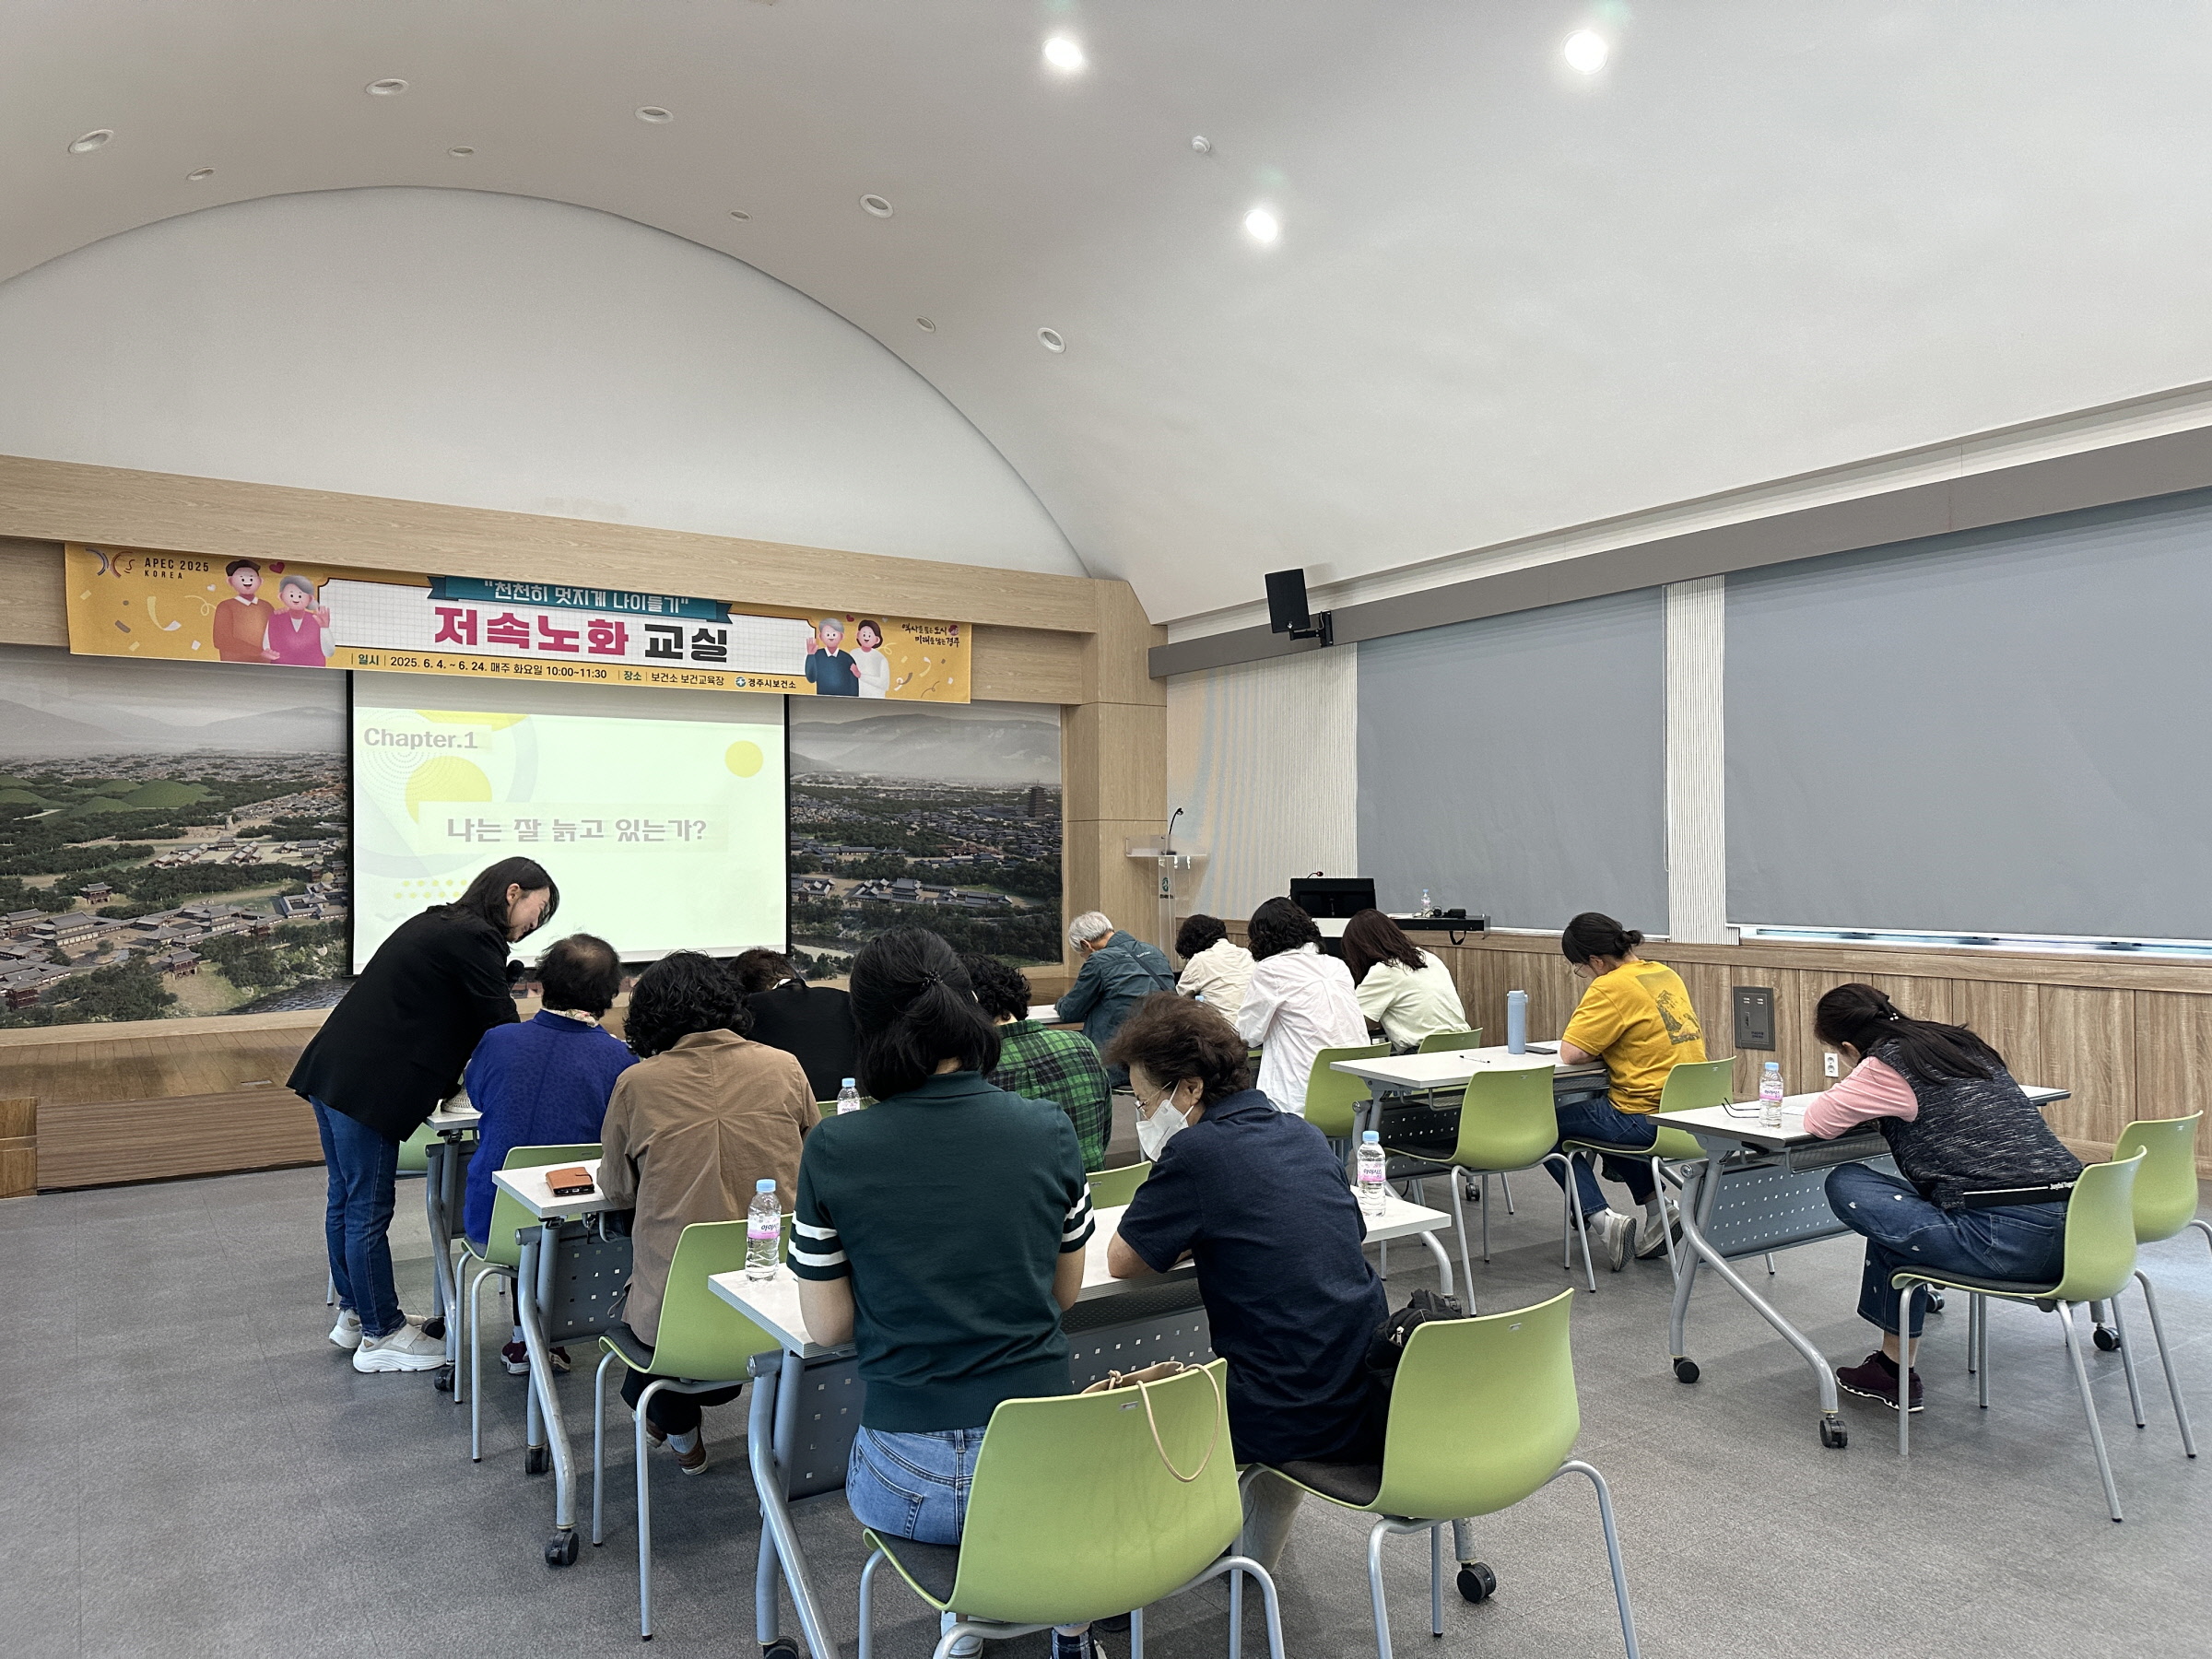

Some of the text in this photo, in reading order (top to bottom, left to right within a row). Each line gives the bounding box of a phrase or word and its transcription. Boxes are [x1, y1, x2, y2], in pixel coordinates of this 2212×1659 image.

[145, 558, 209, 571] APEC 2025
[144, 571, 183, 580] KOREA
[555, 587, 606, 607] 멋지게
[434, 606, 728, 664] 저속노화 교실
[358, 653, 380, 666] 일시
[390, 656, 420, 668] 2025.
[423, 659, 433, 669] 6.
[436, 660, 446, 670] 4.
[458, 661, 468, 672] 6.
[471, 662, 488, 673] 24.
[490, 662, 511, 674] 매주
[513, 664, 543, 676] 화요일
[546, 665, 607, 679] 10:00~11:30
[623, 669, 642, 681] 장소
[651, 672, 678, 684] 보건소
[680, 674, 725, 687] 보건교육장
[747, 677, 797, 689] 경주시보건소
[363, 727, 478, 750] Chapter.1
[447, 818, 707, 843] 나는 잘 늙고 있는가?
